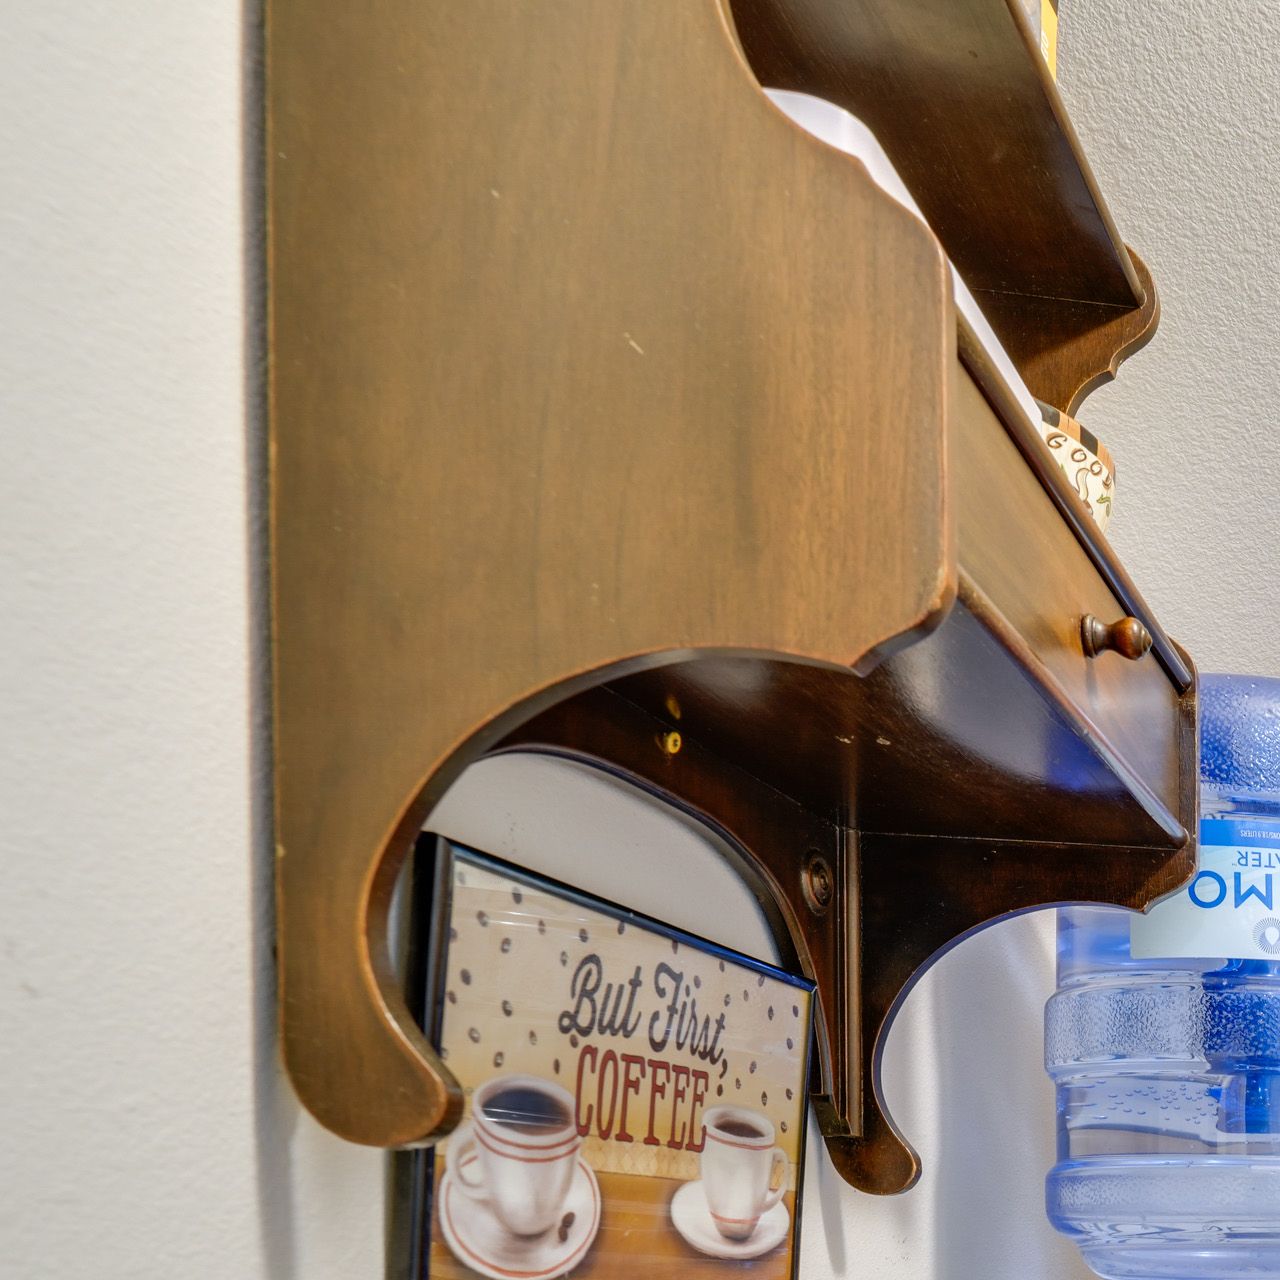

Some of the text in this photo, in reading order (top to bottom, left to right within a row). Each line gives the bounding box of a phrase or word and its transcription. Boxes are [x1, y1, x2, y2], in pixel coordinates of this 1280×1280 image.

[558, 953, 729, 1079] But First,
[575, 1044, 710, 1154] COFFEE
